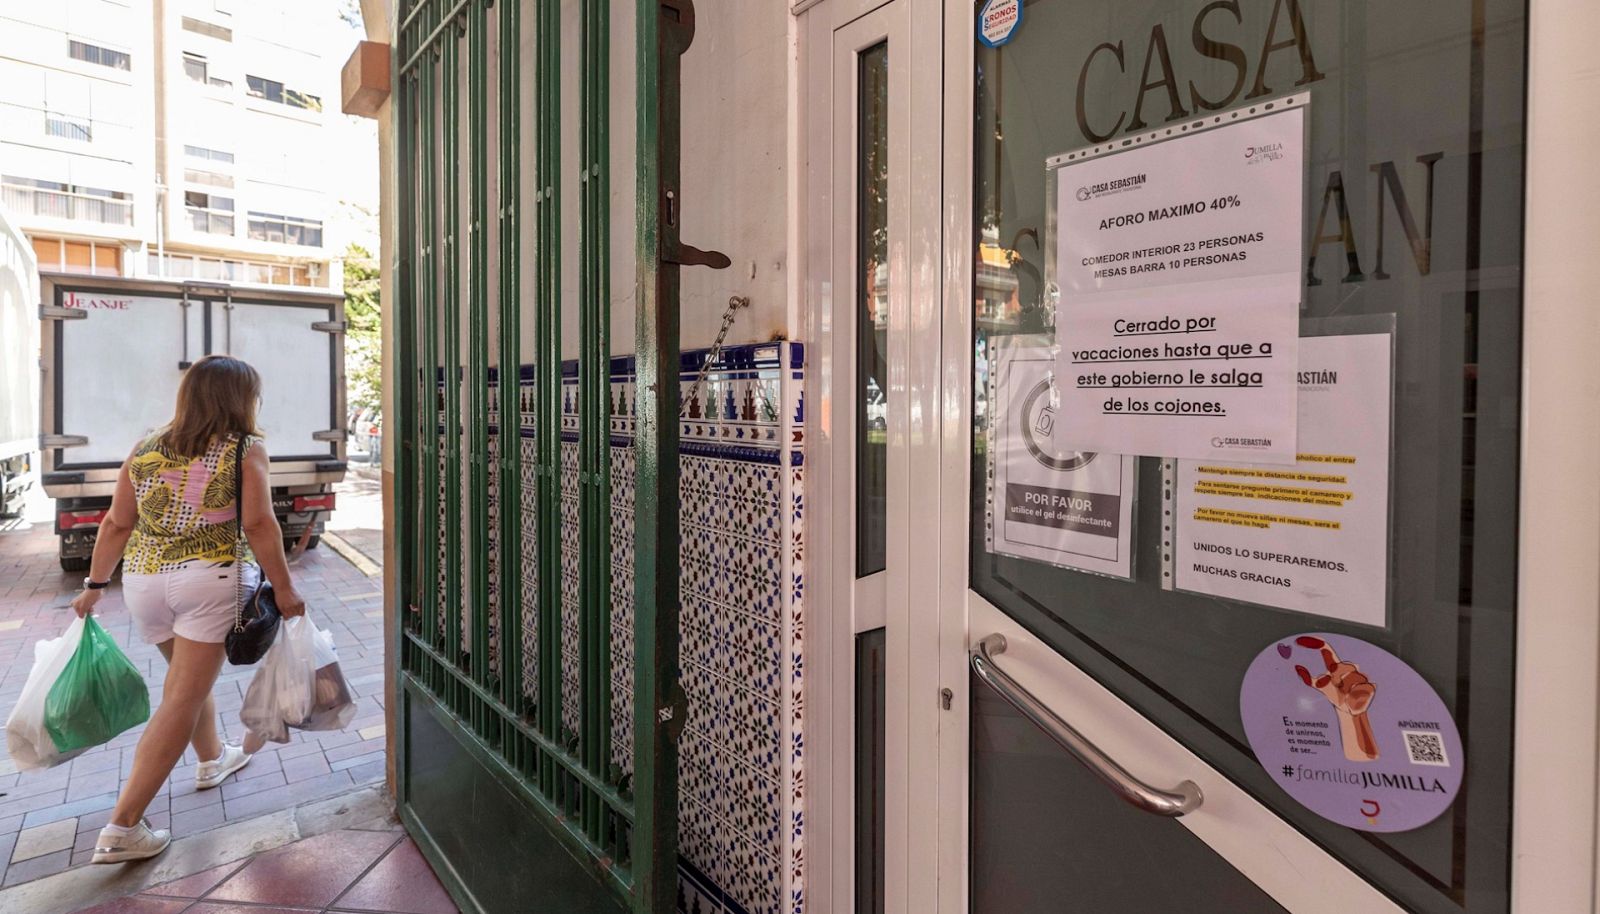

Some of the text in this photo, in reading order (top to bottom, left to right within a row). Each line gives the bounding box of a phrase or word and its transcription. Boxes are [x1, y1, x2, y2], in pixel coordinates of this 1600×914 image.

[1075, 0, 1326, 144] CASA
[1244, 143, 1283, 158] JUMILLA
[1092, 182, 1109, 194] CASA
[1109, 173, 1146, 190] SEBASTIÁN
[1099, 194, 1241, 230] AFORO MAXIMO 40%
[1082, 232, 1264, 266] COMEDOR INTERIOR 23 PERSONAS
[1094, 251, 1247, 279] MESAS BARRA 10 PERSONAS
[1114, 316, 1216, 333] Cerrado por
[1072, 342, 1272, 361] vacaciones hasta que a
[1077, 368, 1263, 388] este gobierno le salga
[1297, 369, 1337, 384] ASTIÁN
[1103, 398, 1226, 414] de los cojones.
[1225, 437, 1239, 445] CASA
[1333, 456, 1356, 464] entrar
[1198, 466, 1228, 475] Mantenga
[1308, 475, 1347, 483] seguridad.
[1257, 492, 1301, 502] indicaciones
[1272, 486, 1300, 495] primero
[1309, 490, 1344, 499] camarero
[1025, 492, 1092, 512] POR FAVOR
[1011, 505, 1112, 528] utilice el gel desinfectante
[1260, 514, 1277, 522] sillas
[1193, 542, 1349, 573] UNIDOS LO SUPERAREMOS.
[1193, 563, 1292, 588] MUCHAS GRACIAS
[1283, 716, 1293, 726] Es
[1398, 719, 1440, 730] APÚNTATE
[1297, 738, 1331, 746] momento
[1282, 764, 1447, 794] #familiaJUMILLA
